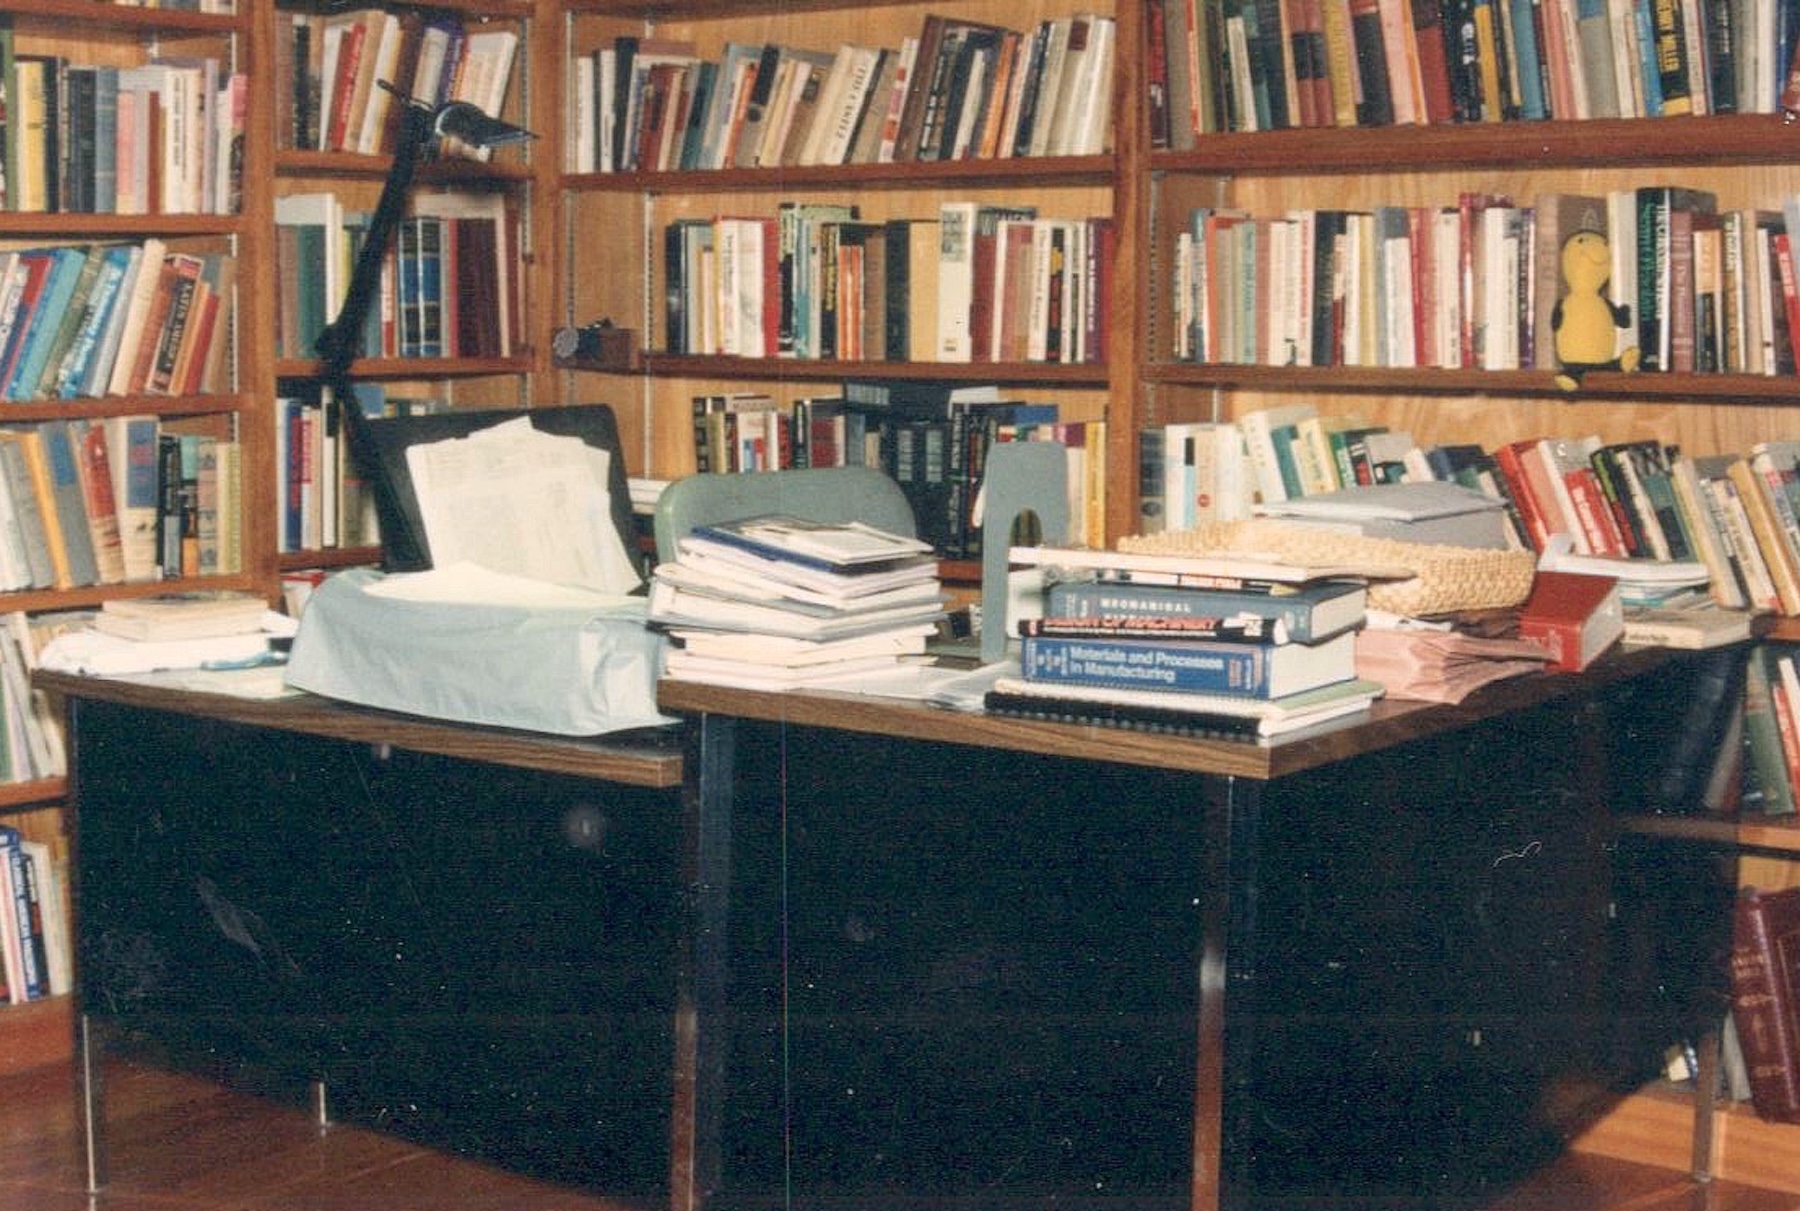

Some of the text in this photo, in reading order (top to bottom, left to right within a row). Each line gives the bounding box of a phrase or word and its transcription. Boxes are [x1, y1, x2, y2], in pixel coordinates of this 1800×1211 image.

[1101, 598, 1191, 613] MECHANICAL
[1071, 646, 1126, 662] Materials
[1127, 650, 1154, 665] and
[1155, 651, 1223, 670] Processes
[1070, 660, 1175, 684] in Manufacturing
